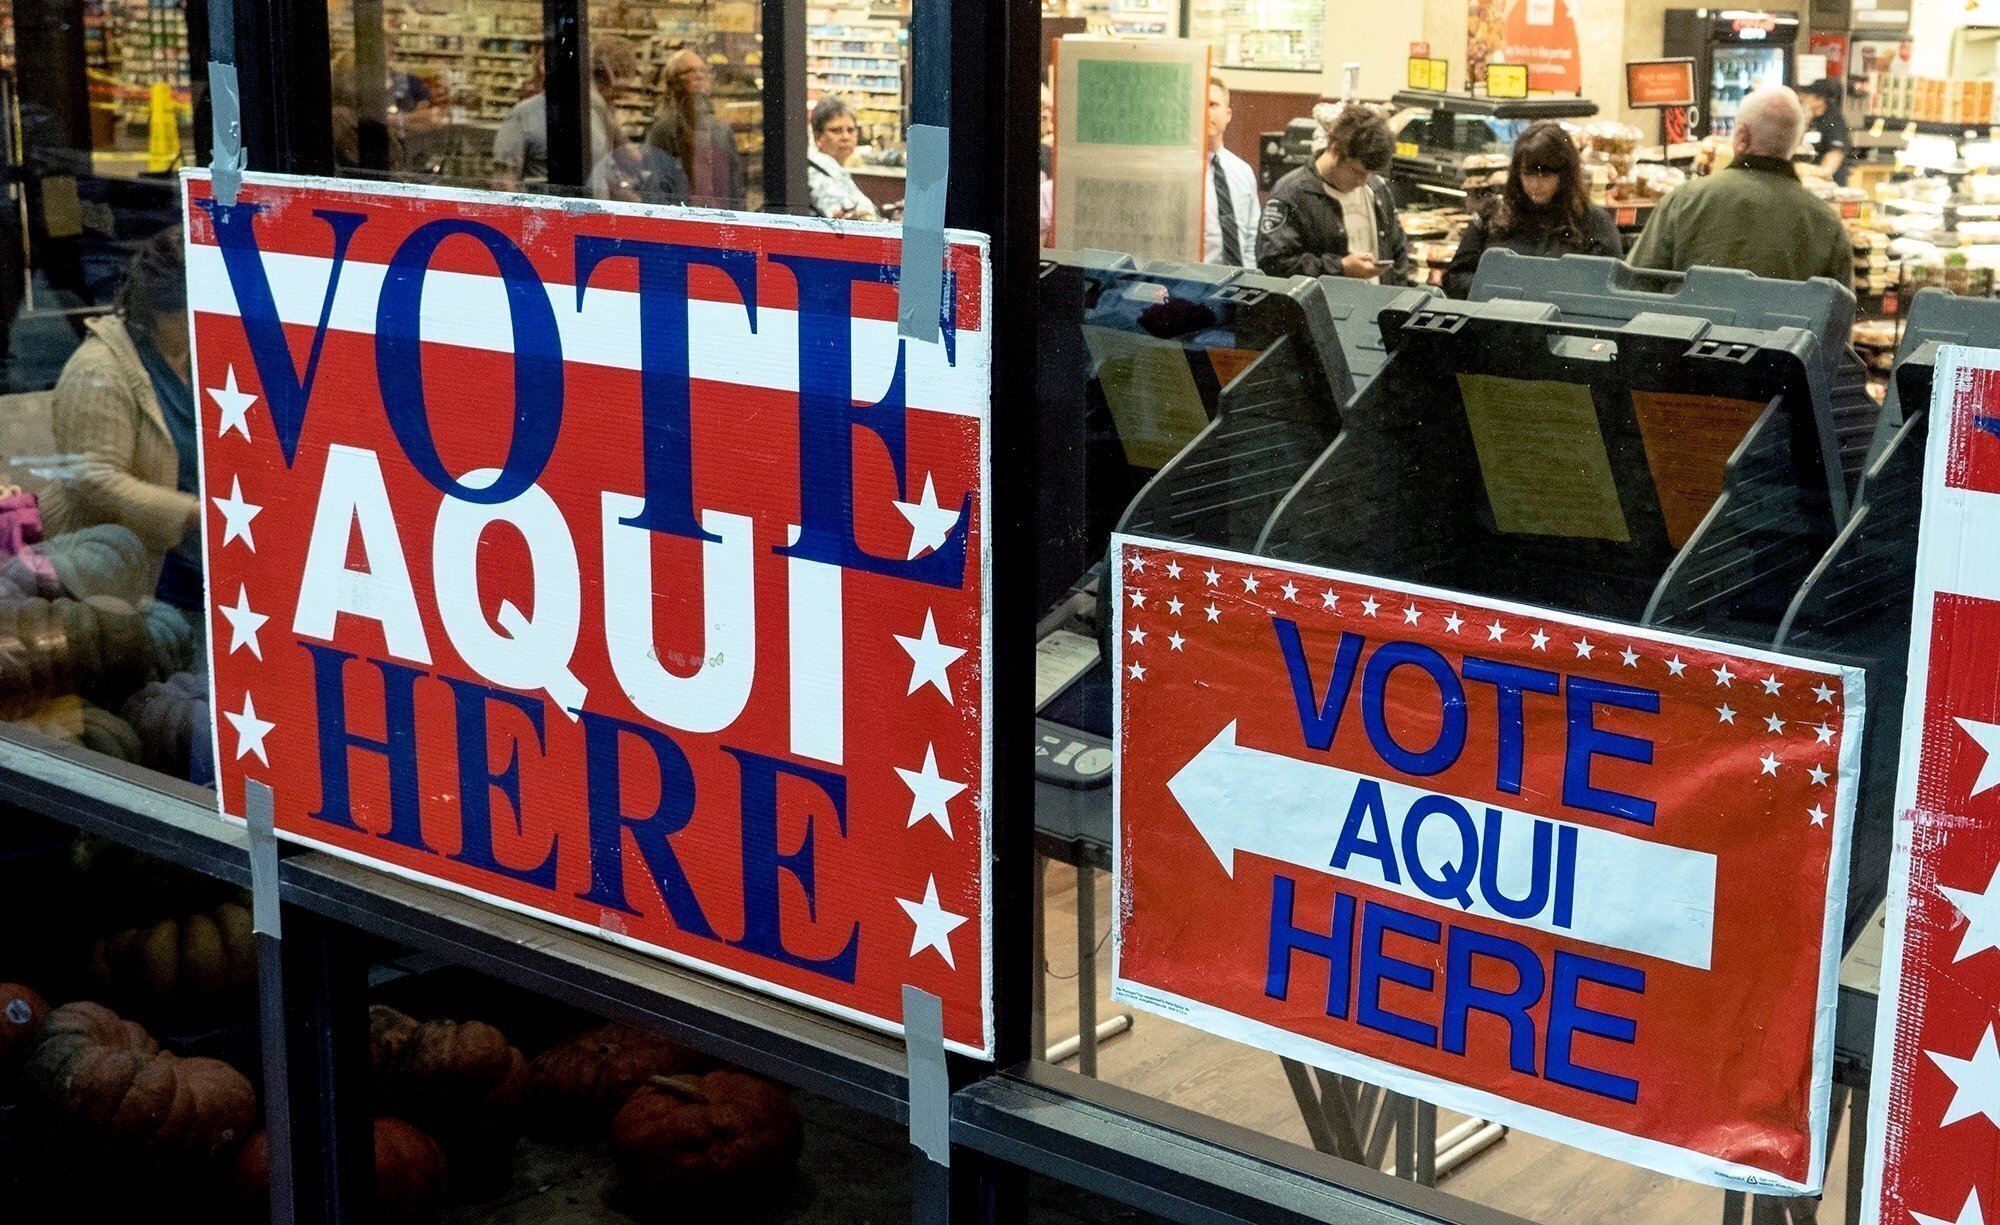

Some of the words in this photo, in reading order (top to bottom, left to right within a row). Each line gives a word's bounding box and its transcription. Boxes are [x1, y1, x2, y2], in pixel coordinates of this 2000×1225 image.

[195, 198, 972, 589] VOTE
[293, 443, 844, 767] AQUI
[1273, 617, 1660, 826] VOTE
[298, 640, 860, 984] HERE
[1329, 778, 1579, 930] AQUI
[1265, 875, 1645, 1104] HERE
